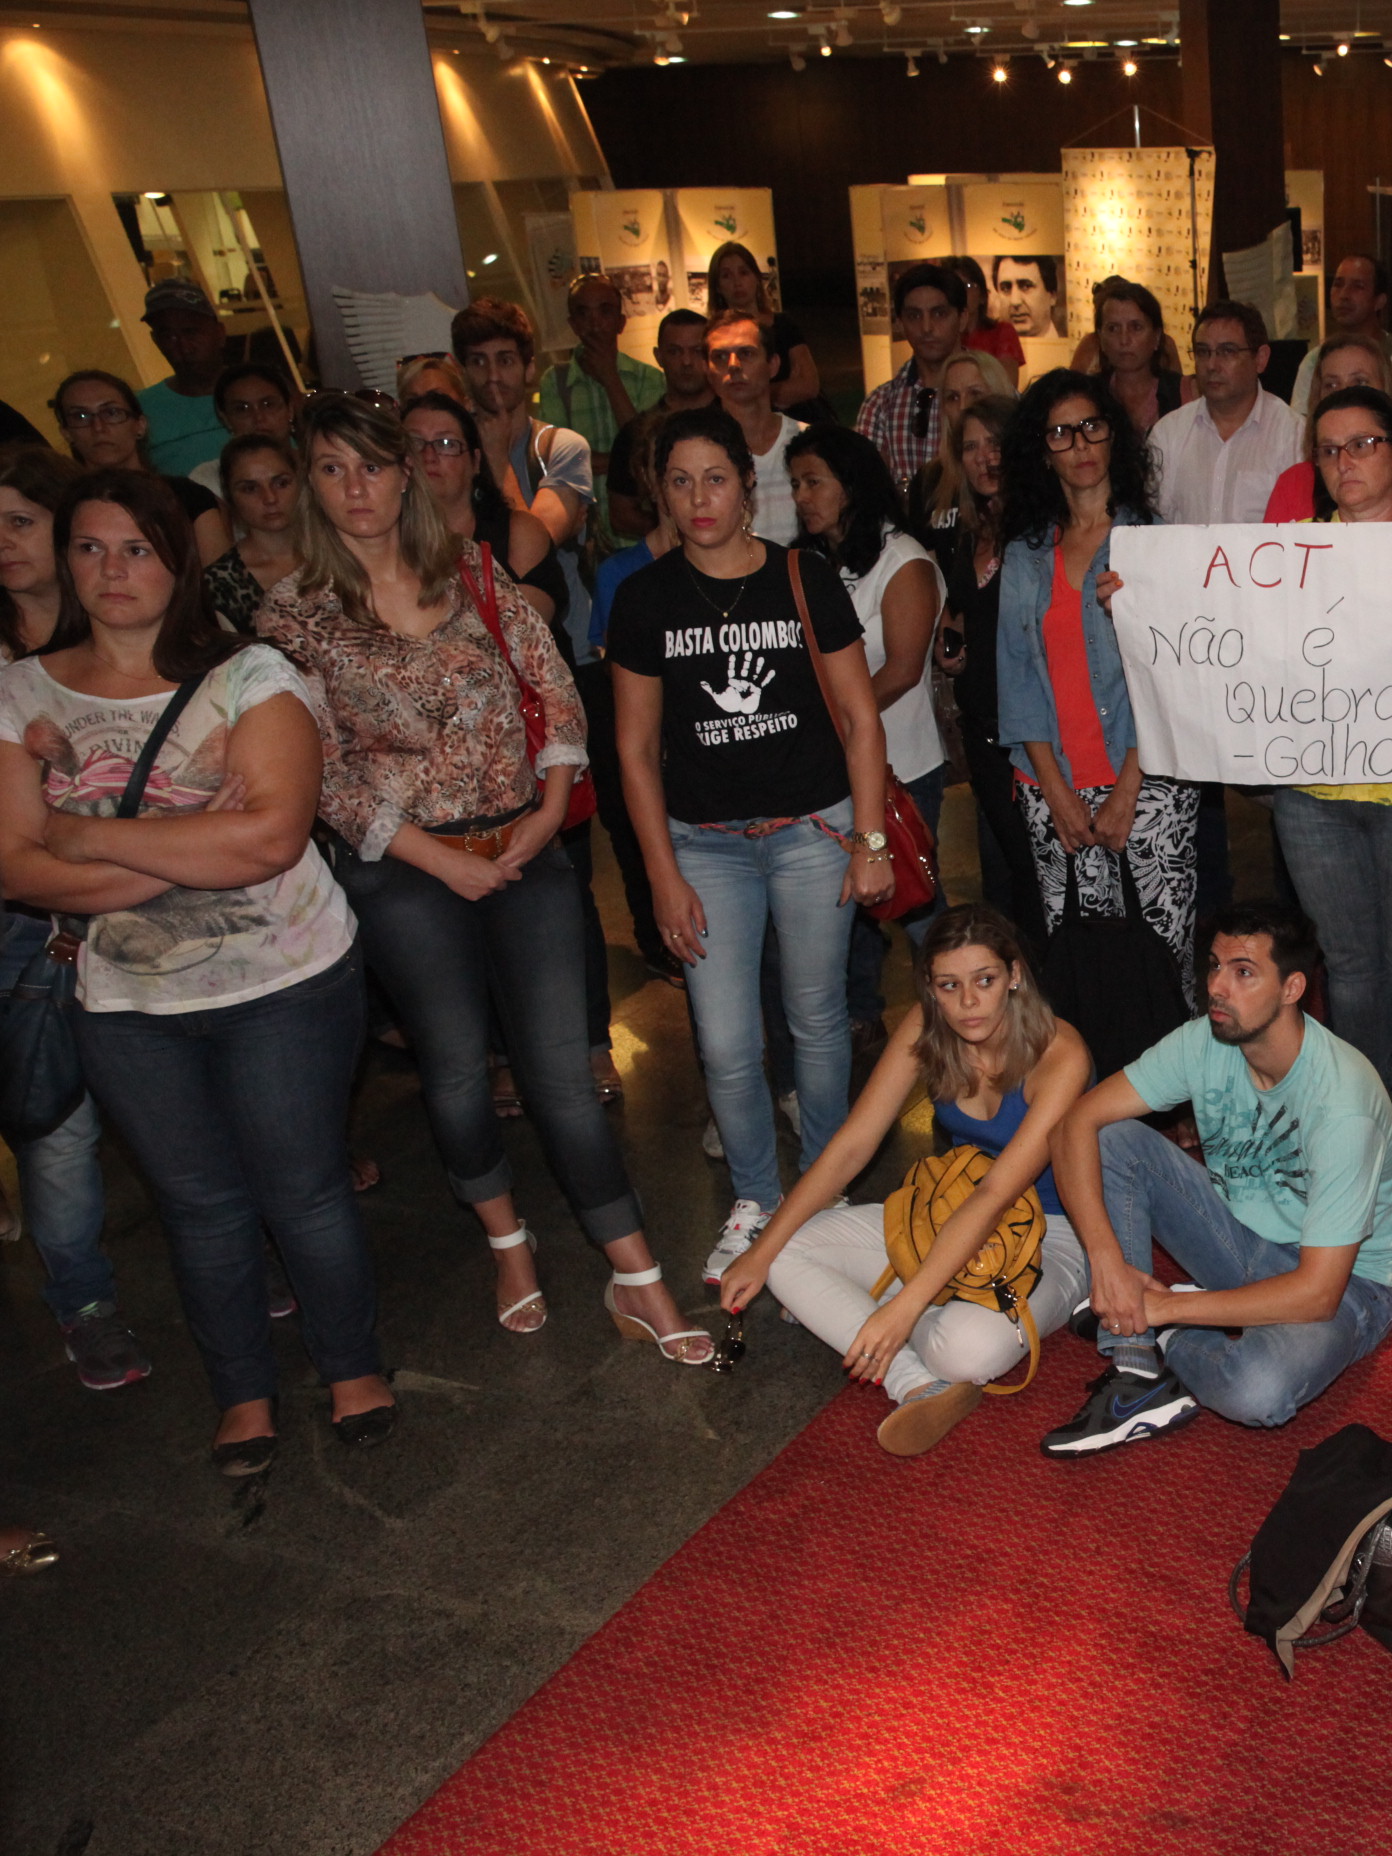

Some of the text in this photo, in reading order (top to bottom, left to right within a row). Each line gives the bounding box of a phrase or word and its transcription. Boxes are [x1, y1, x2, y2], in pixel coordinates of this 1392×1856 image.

[1203, 541, 1333, 589] ACT
[665, 626, 715, 658] BASTA
[1149, 596, 1345, 668] Não é
[64, 711, 107, 740] UNDER
[110, 709, 136, 722] THE
[695, 721, 702, 732] O
[703, 715, 746, 732] SERVIÇO
[734, 713, 798, 742] RESPEITO
